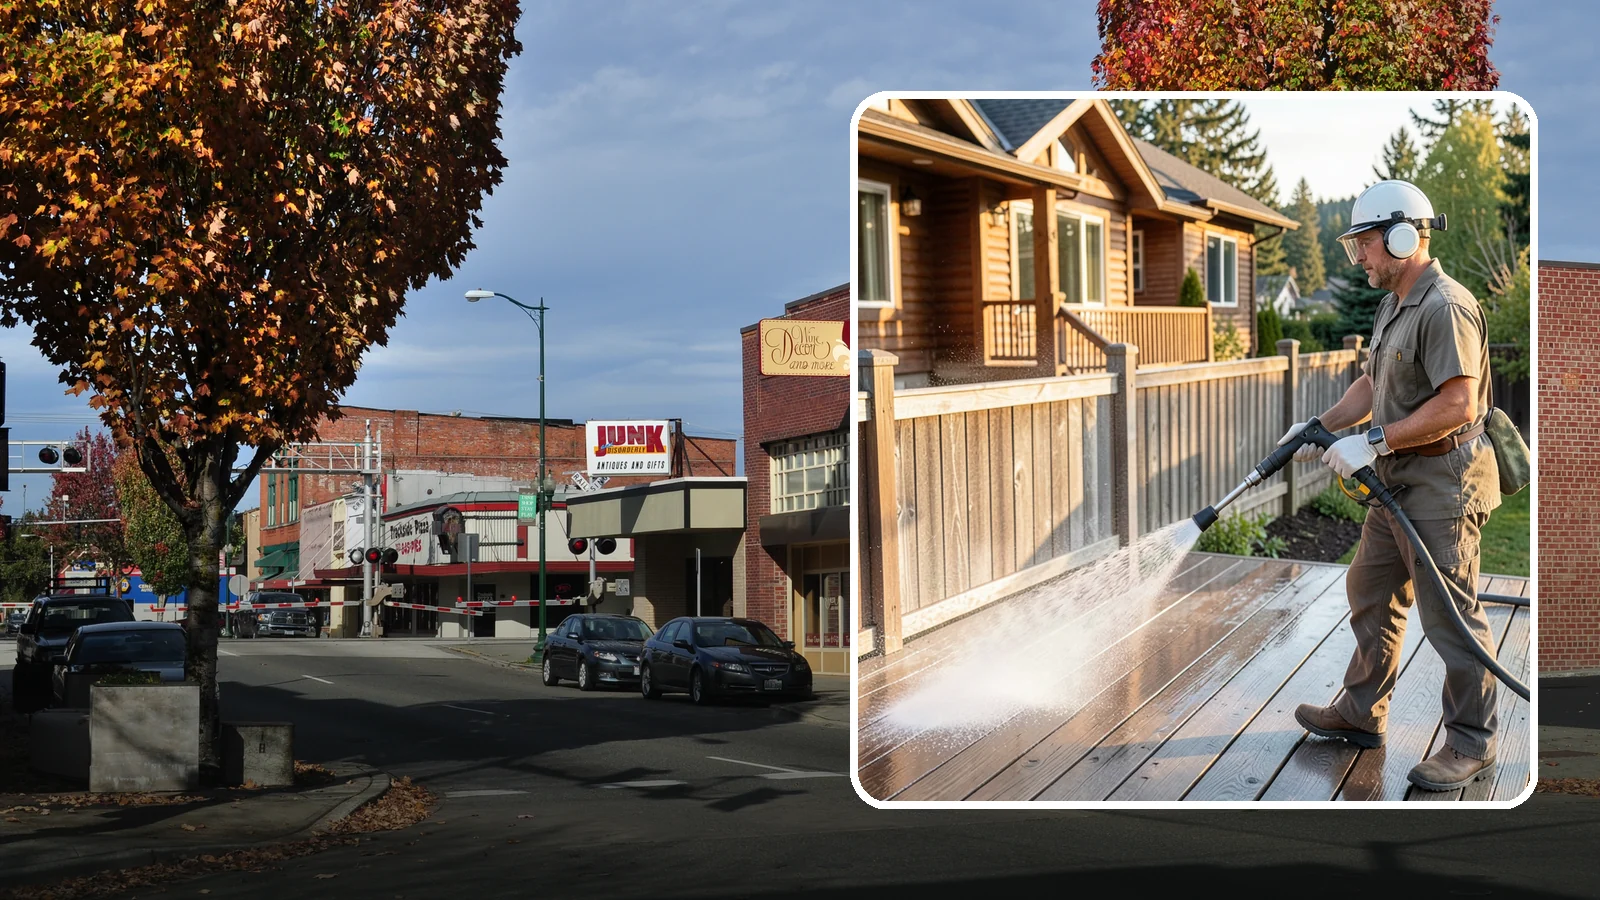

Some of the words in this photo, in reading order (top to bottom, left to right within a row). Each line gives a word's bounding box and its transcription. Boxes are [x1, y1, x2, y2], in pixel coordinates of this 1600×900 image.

[765, 328, 830, 365] Decor
[596, 425, 665, 457] JUNK
[607, 446, 646, 454] DISORDERLY
[597, 461, 628, 470] ANTIQUES
[631, 461, 643, 470] AND
[647, 460, 665, 469] GIFTS
[414, 519, 429, 535] Pizza
